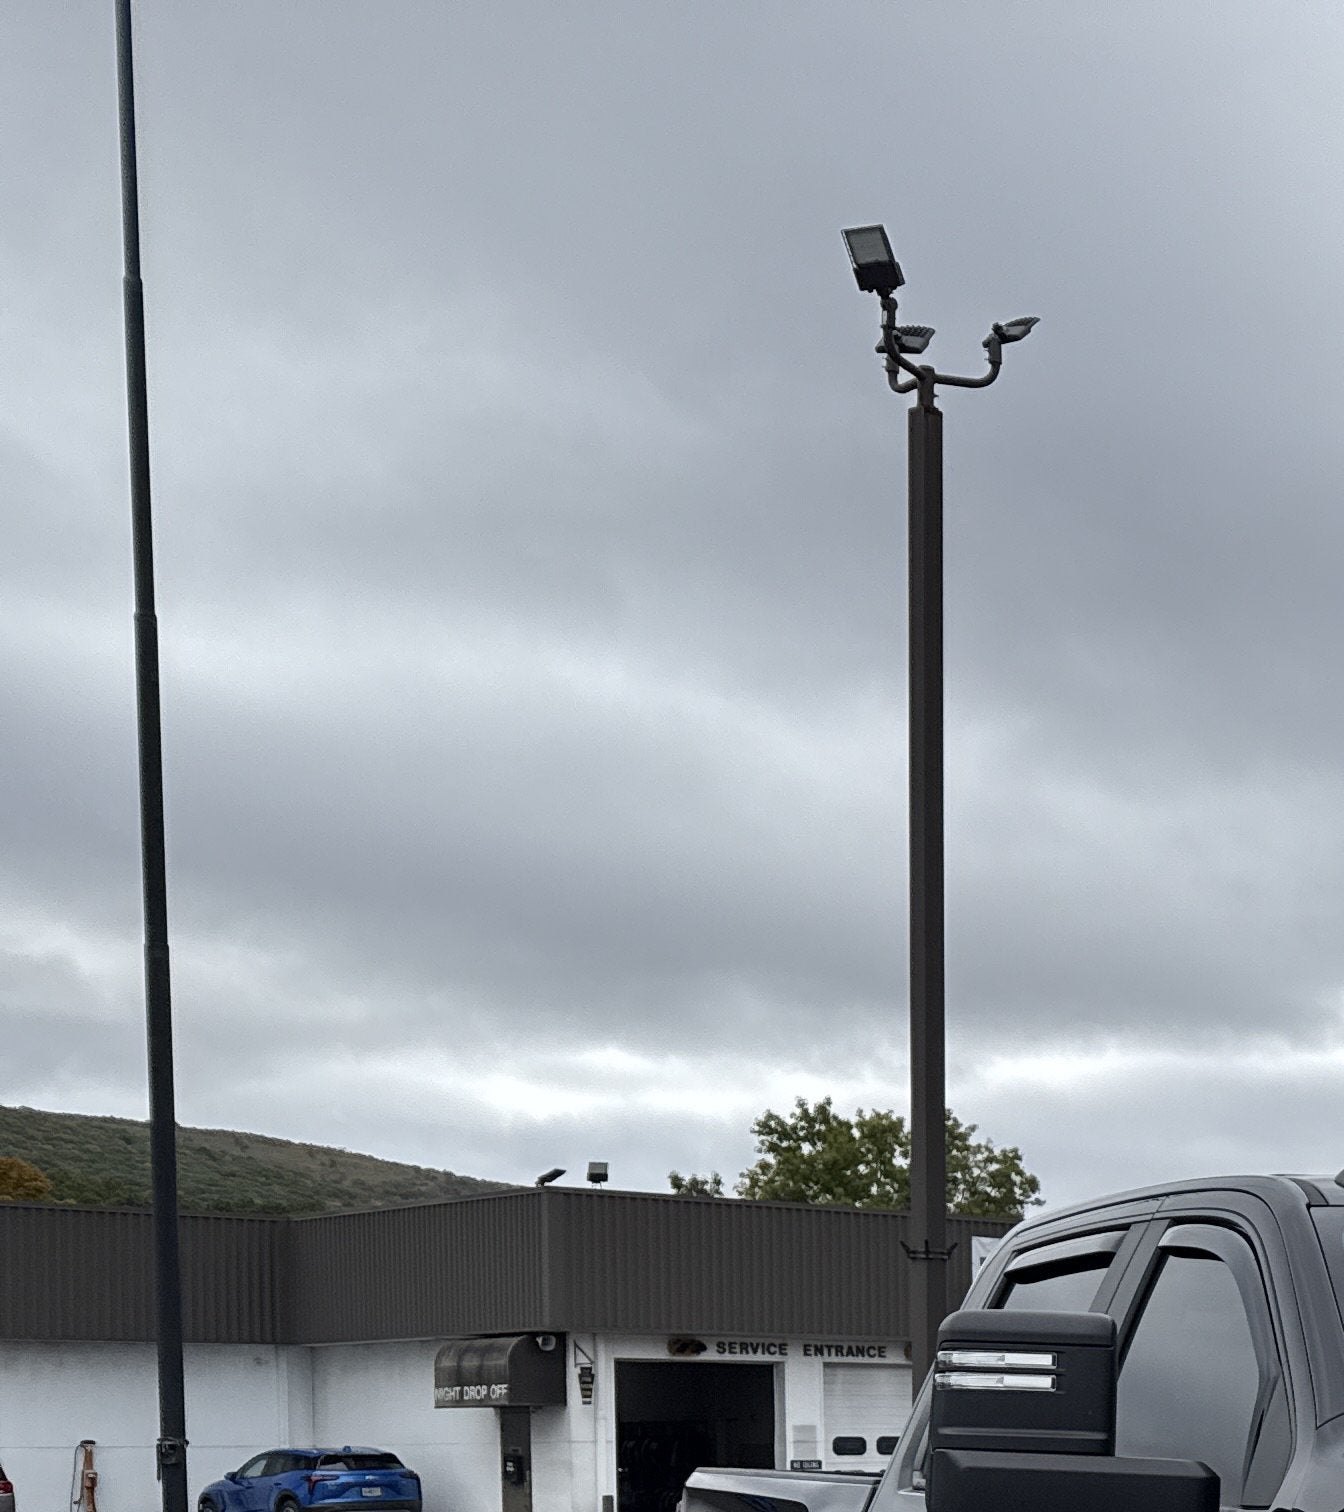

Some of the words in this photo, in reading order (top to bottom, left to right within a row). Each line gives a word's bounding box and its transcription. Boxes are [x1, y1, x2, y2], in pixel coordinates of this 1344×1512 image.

[716, 1341, 788, 1356] SERVICE
[803, 1344, 887, 1358] ENTRANCE
[463, 1384, 487, 1400] DROP
[490, 1383, 508, 1399] OFF
